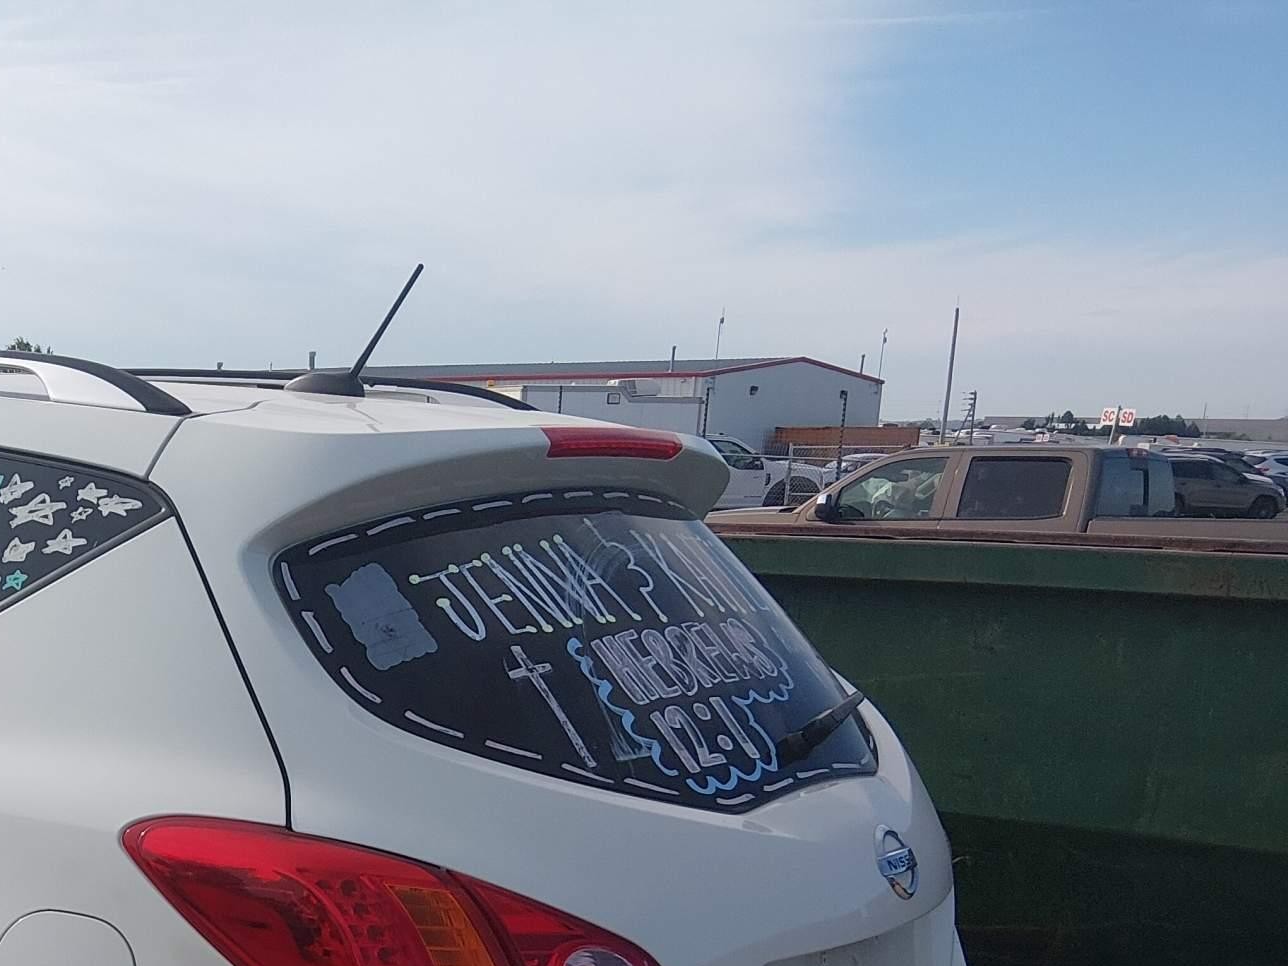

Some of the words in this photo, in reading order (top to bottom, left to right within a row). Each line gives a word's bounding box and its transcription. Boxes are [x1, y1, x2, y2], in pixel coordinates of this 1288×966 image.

[1102, 410, 1115, 422] SC
[1121, 411, 1134, 424] SD
[408, 533, 642, 642] JENNA
[590, 617, 779, 705] HEBREWS
[649, 696, 761, 774] 12:1
